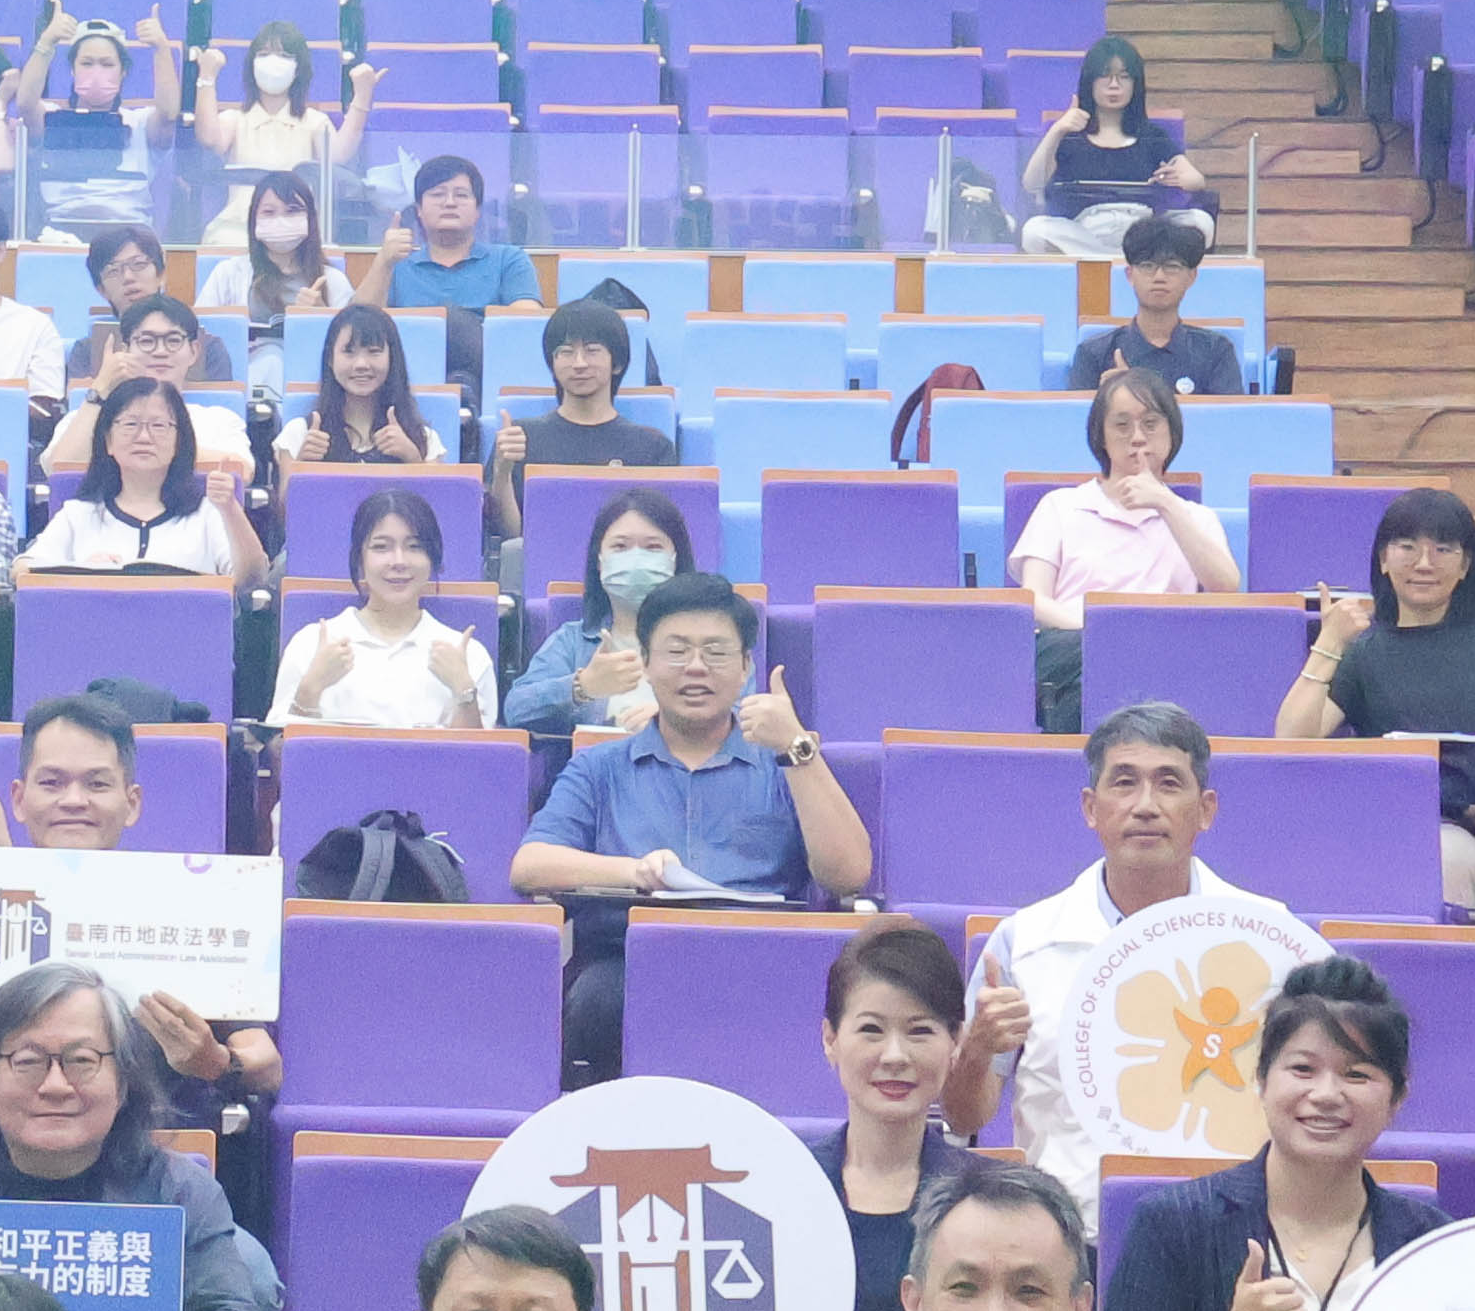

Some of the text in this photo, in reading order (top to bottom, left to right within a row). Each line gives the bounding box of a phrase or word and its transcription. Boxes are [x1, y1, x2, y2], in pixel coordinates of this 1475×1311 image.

[66, 922, 250, 948] 臺南市地政法學會
[1075, 912, 1308, 1098] COLLEGE OF SOCIAL SCIENCES NATIONAL
